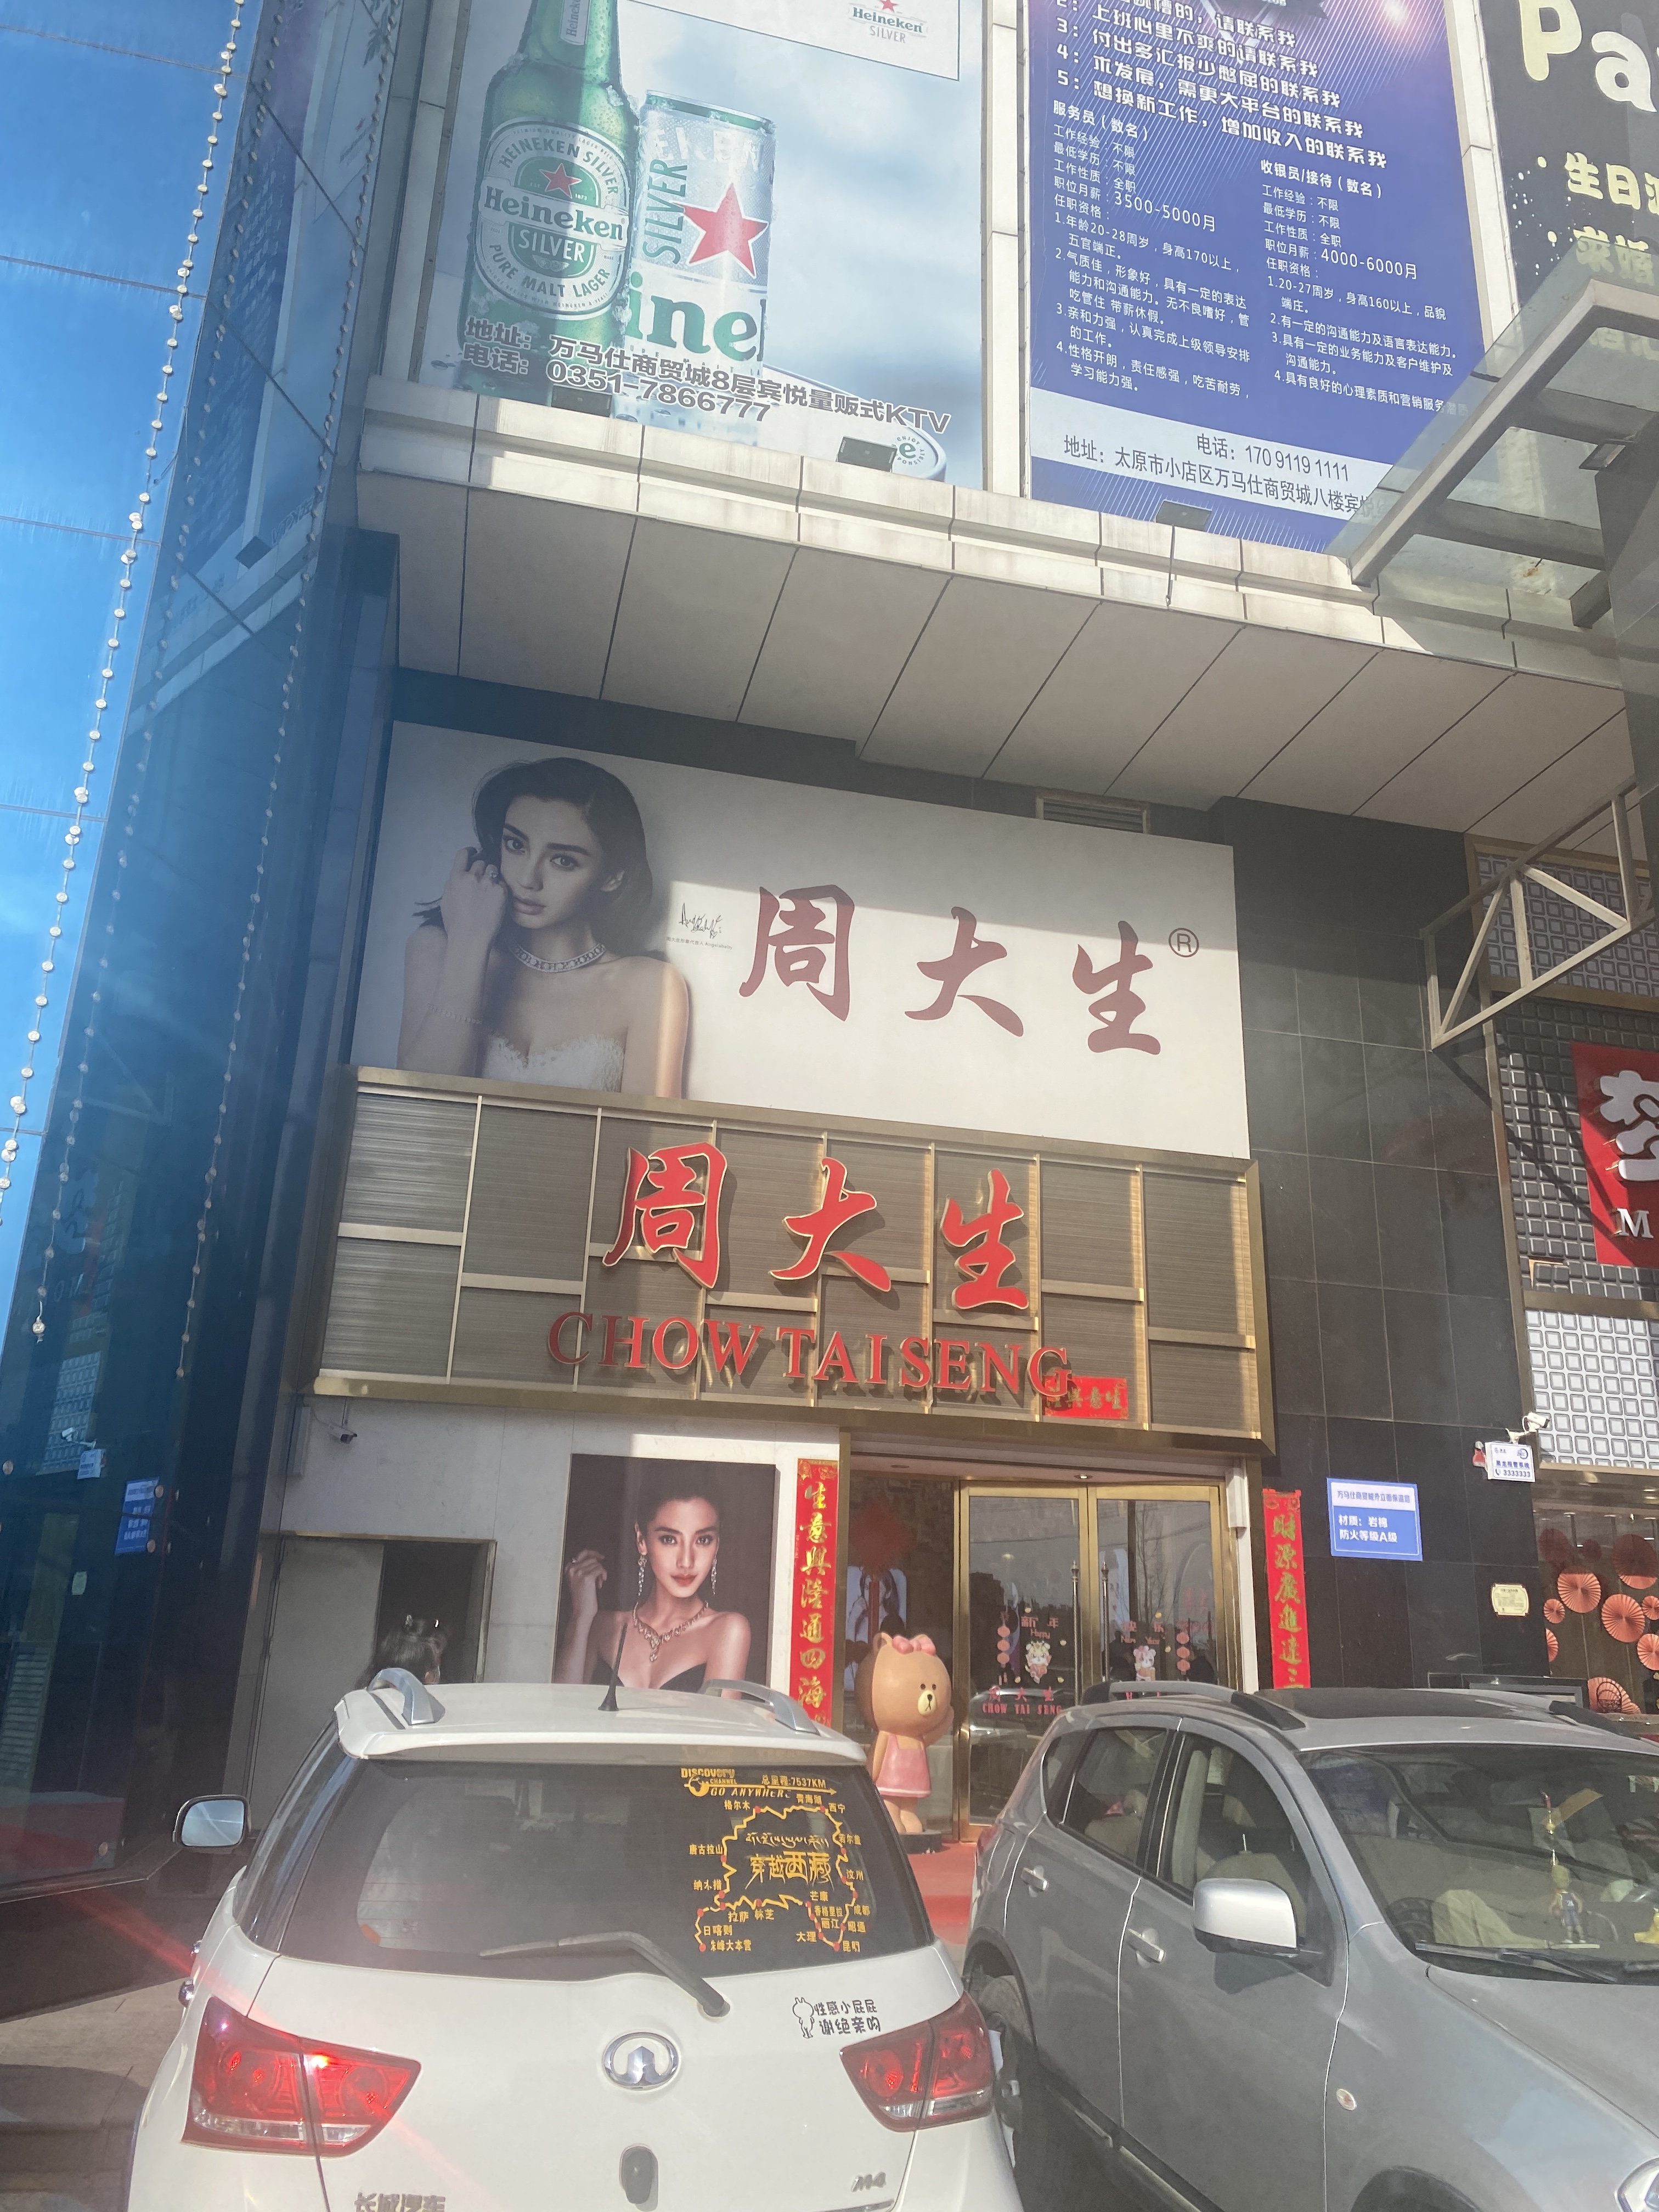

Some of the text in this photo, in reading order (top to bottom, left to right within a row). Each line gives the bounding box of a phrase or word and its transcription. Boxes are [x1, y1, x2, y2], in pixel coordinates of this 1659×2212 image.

[853, 7, 923, 33] Heineken
[870, 25, 906, 43] SILVER
[1520, 0, 1659, 112] Pa
[499, 138, 619, 195] HEINEKEN SILVER
[484, 185, 624, 241] Heineken
[642, 159, 688, 264] SILVER
[518, 229, 585, 263] SILVER
[1069, 233, 1121, 259] 五官端正。
[489, 244, 610, 298] PURE MALT LAGER
[1281, 296, 1308, 313] 端庄。
[1070, 325, 1112, 348] 的工作。
[1285, 352, 1336, 375] 沟通能力。
[1070, 363, 1138, 392] 学习能力强。
[1276, 449, 1311, 474] 9119
[1315, 458, 1350, 482] 1111
[739, 884, 1161, 1055] 周大生
[602, 1141, 1029, 1310] 周大生
[548, 1311, 764, 1376] CHOW
[1339, 1529, 1398, 1543] 防火等级A级
[983, 1703, 1007, 1714] CHOW
[1015, 1703, 1030, 1714] TAI
[724, 1799, 751, 1810] 格尔木
[796, 1793, 822, 1805] 青海湖
[828, 1803, 845, 1813] 西宁
[689, 1844, 723, 1855] 唐古拉山
[744, 1850, 834, 1891] 穿越西藏
[727, 1910, 749, 1922] 拉萨
[754, 1908, 775, 1920] 林芝
[703, 1925, 732, 1936] 日喀则
[795, 1931, 817, 1942] 大理
[814, 1999, 878, 2016] 性感小屁屁
[819, 2016, 881, 2036] 谢绝亲吻
